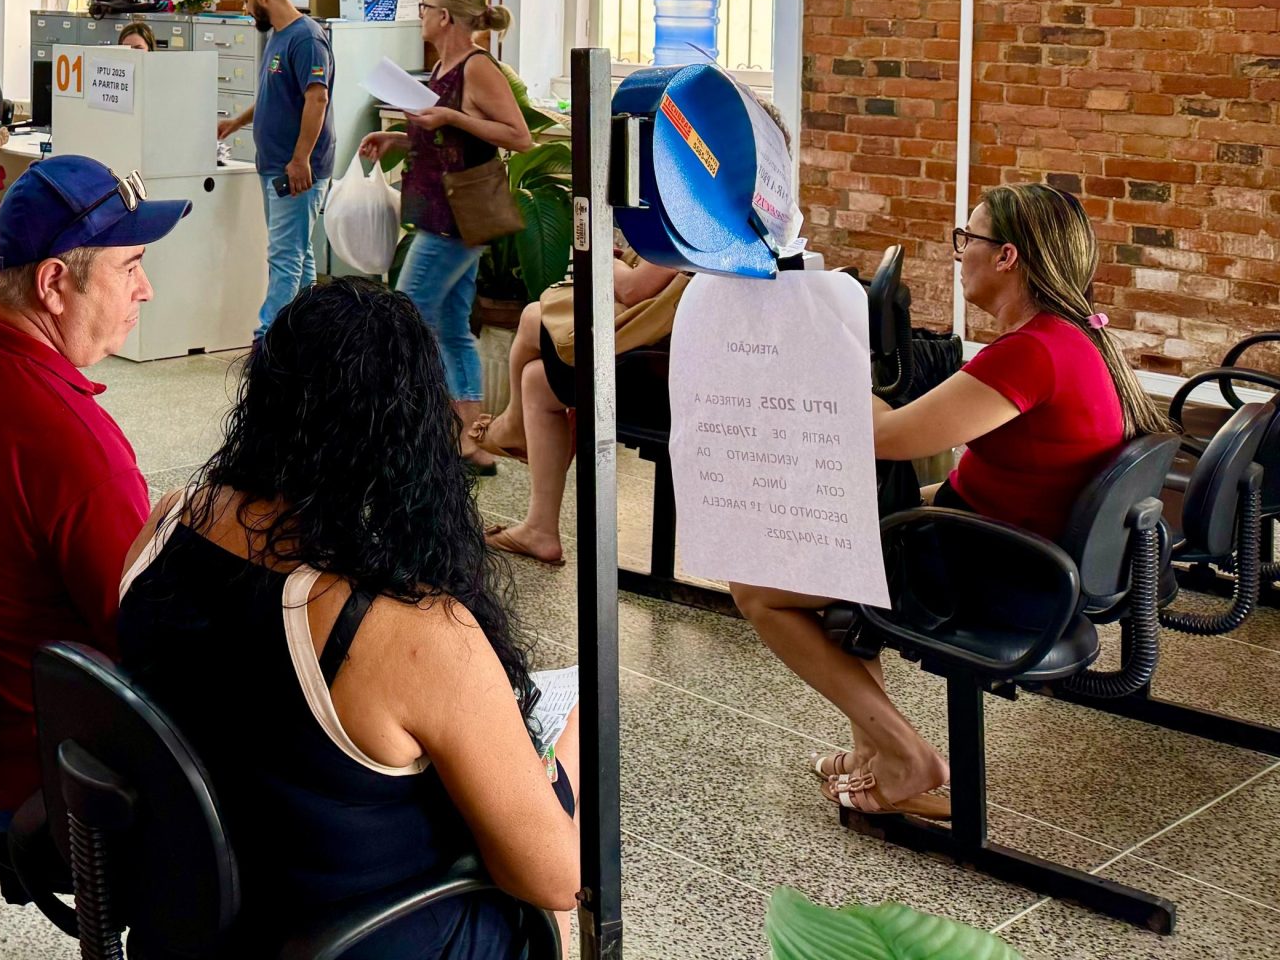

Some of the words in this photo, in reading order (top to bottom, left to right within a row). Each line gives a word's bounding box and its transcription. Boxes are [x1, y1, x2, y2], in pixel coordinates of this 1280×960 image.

[56, 54, 82, 92] 01
[97, 66, 111, 76] IPTU
[112, 68, 126, 78] 2025
[92, 79, 97, 87] A
[98, 80, 120, 91] PARTIR
[121, 83, 129, 91] DE
[102, 94, 119, 103] 17/03
